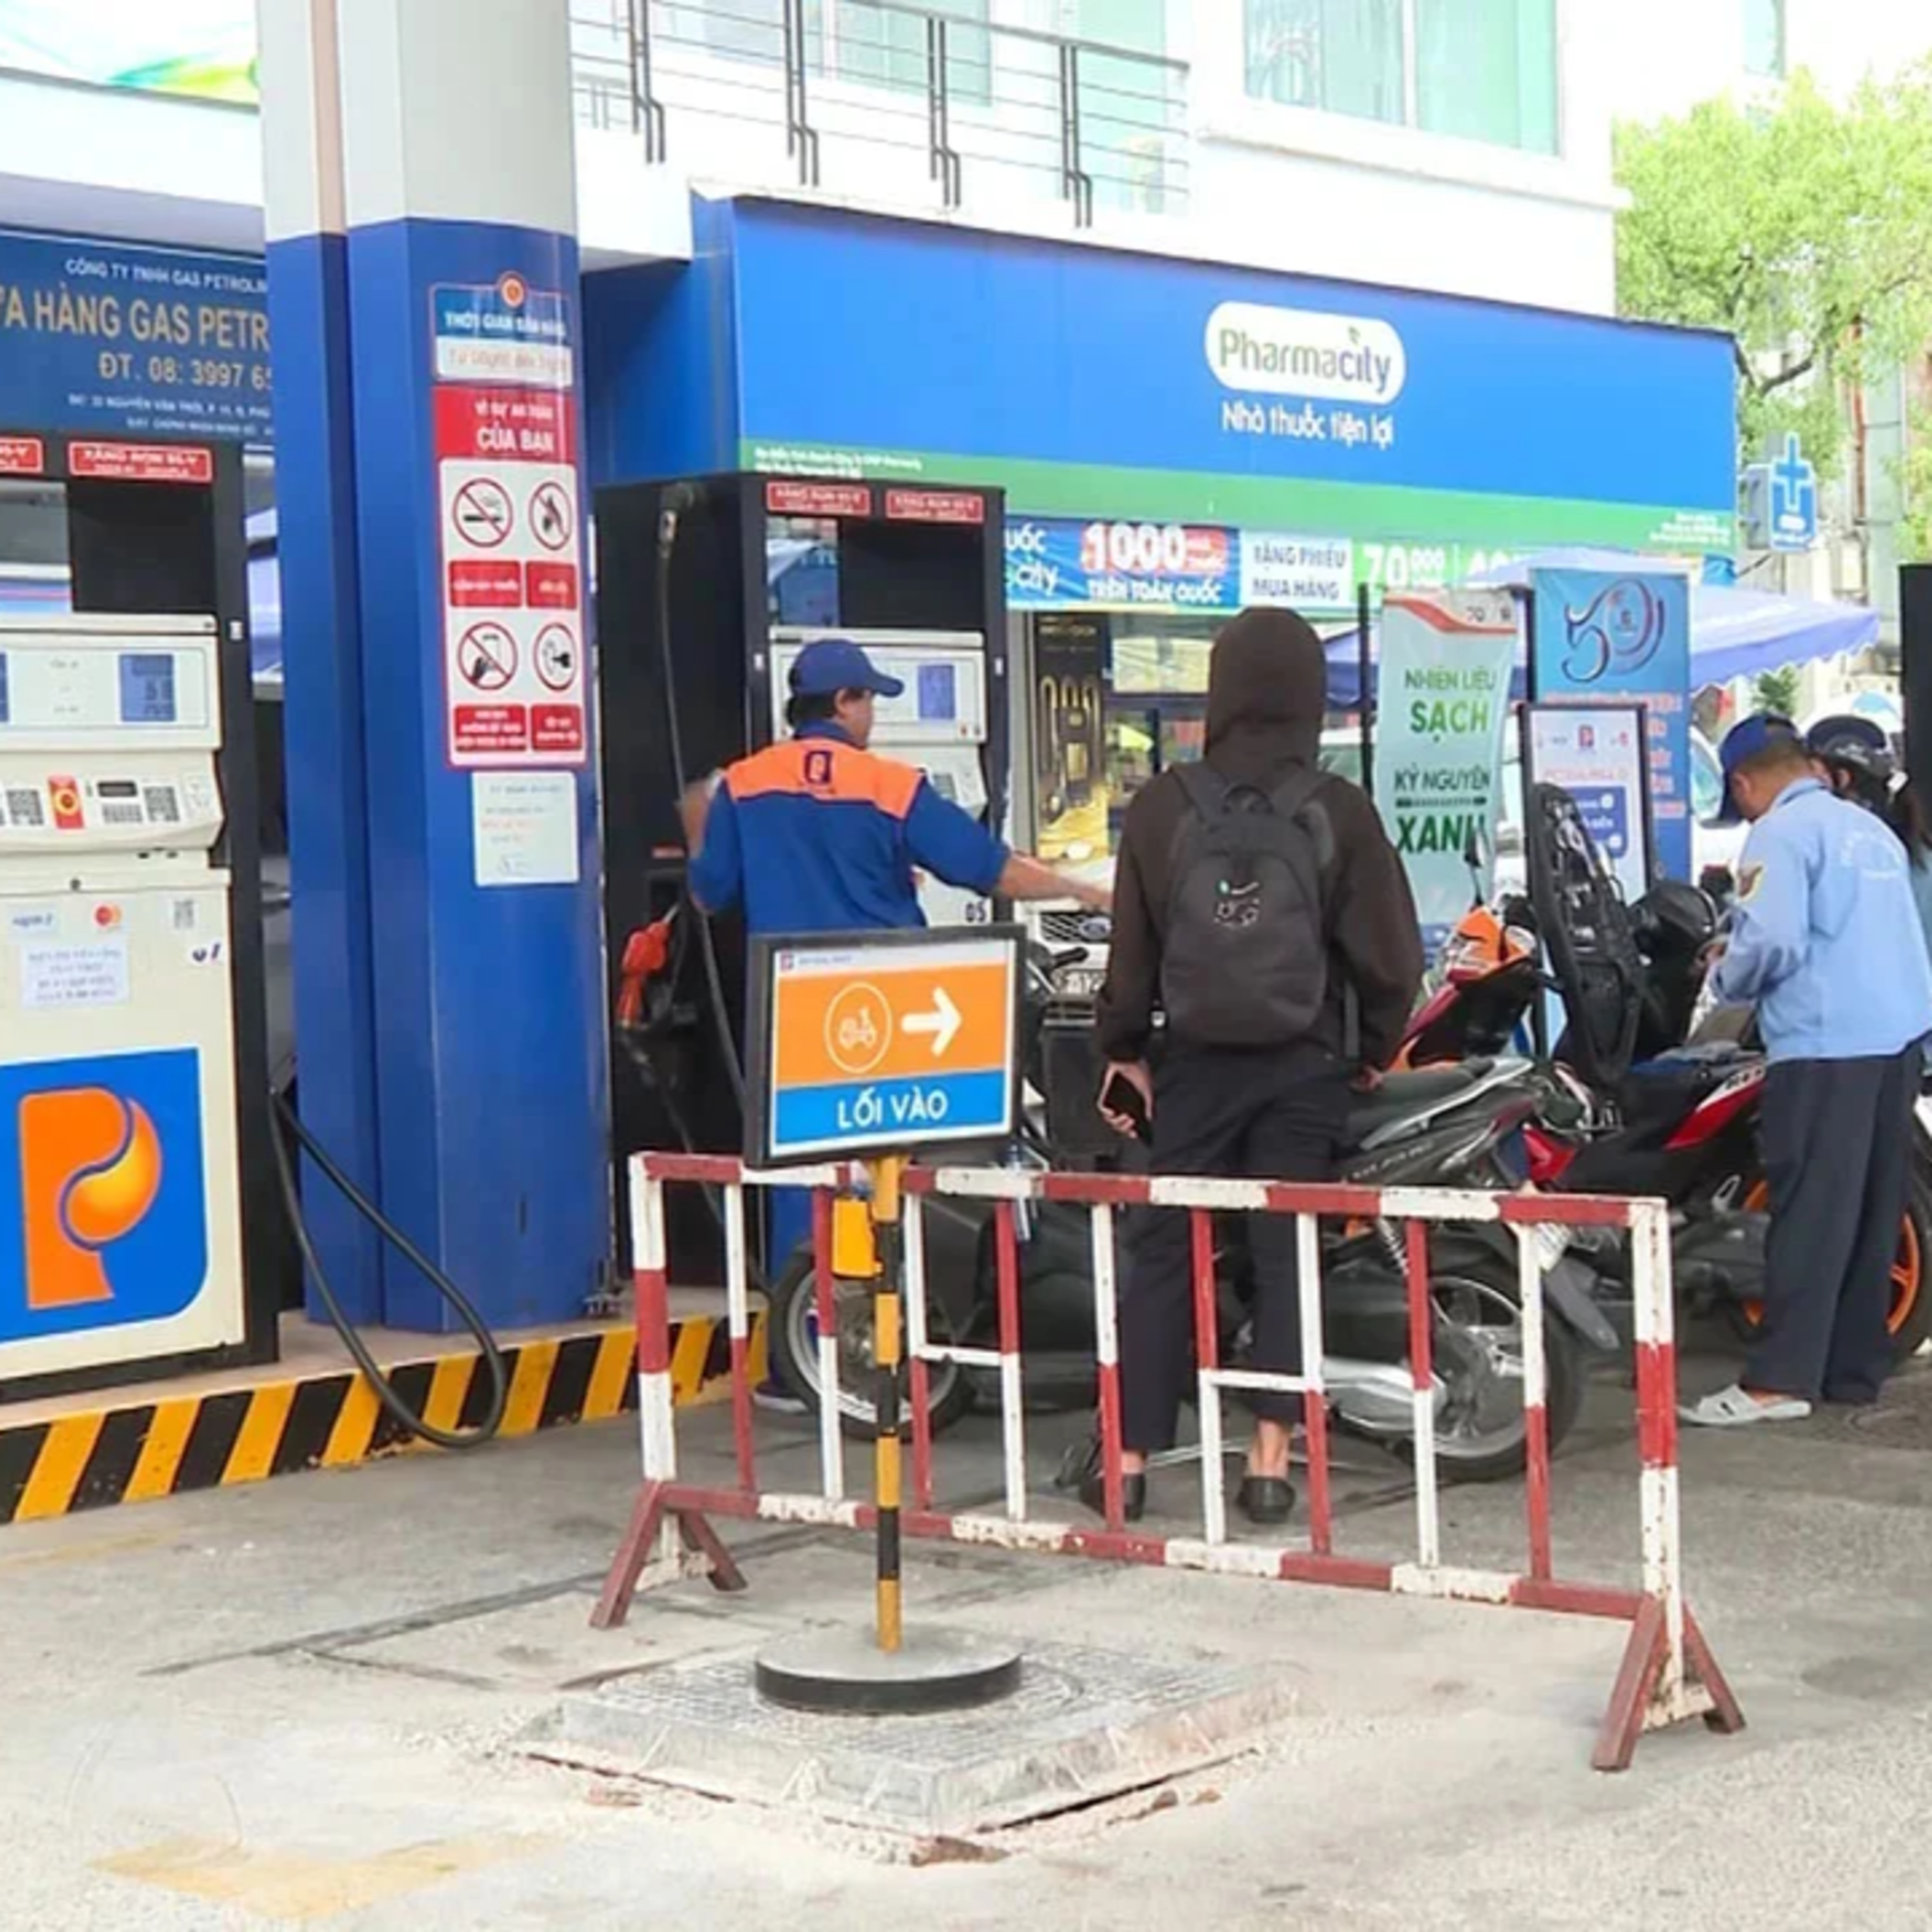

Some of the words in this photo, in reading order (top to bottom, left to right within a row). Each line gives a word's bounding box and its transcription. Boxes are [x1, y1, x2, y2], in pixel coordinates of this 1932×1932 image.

[112, 263, 128, 278] TY
[172, 269, 200, 289] GAS
[0, 285, 27, 328] A
[34, 281, 121, 339] HÀNG
[129, 299, 191, 347] GAS
[198, 305, 270, 352] PETR
[190, 360, 244, 388] 3997
[1219, 326, 1392, 395] Pharmacity
[1221, 399, 1265, 435] Nhà
[1270, 401, 1326, 441] thuốc
[1083, 521, 1186, 572] 1000
[1294, 576, 1340, 600] HÀNG
[1405, 666, 1458, 691] NHIÊN
[1410, 700, 1489, 743] SẠCH
[1422, 764, 1492, 793] NGUYÊN
[838, 1086, 882, 1130] LỐI
[890, 1085, 949, 1121] VÀO
